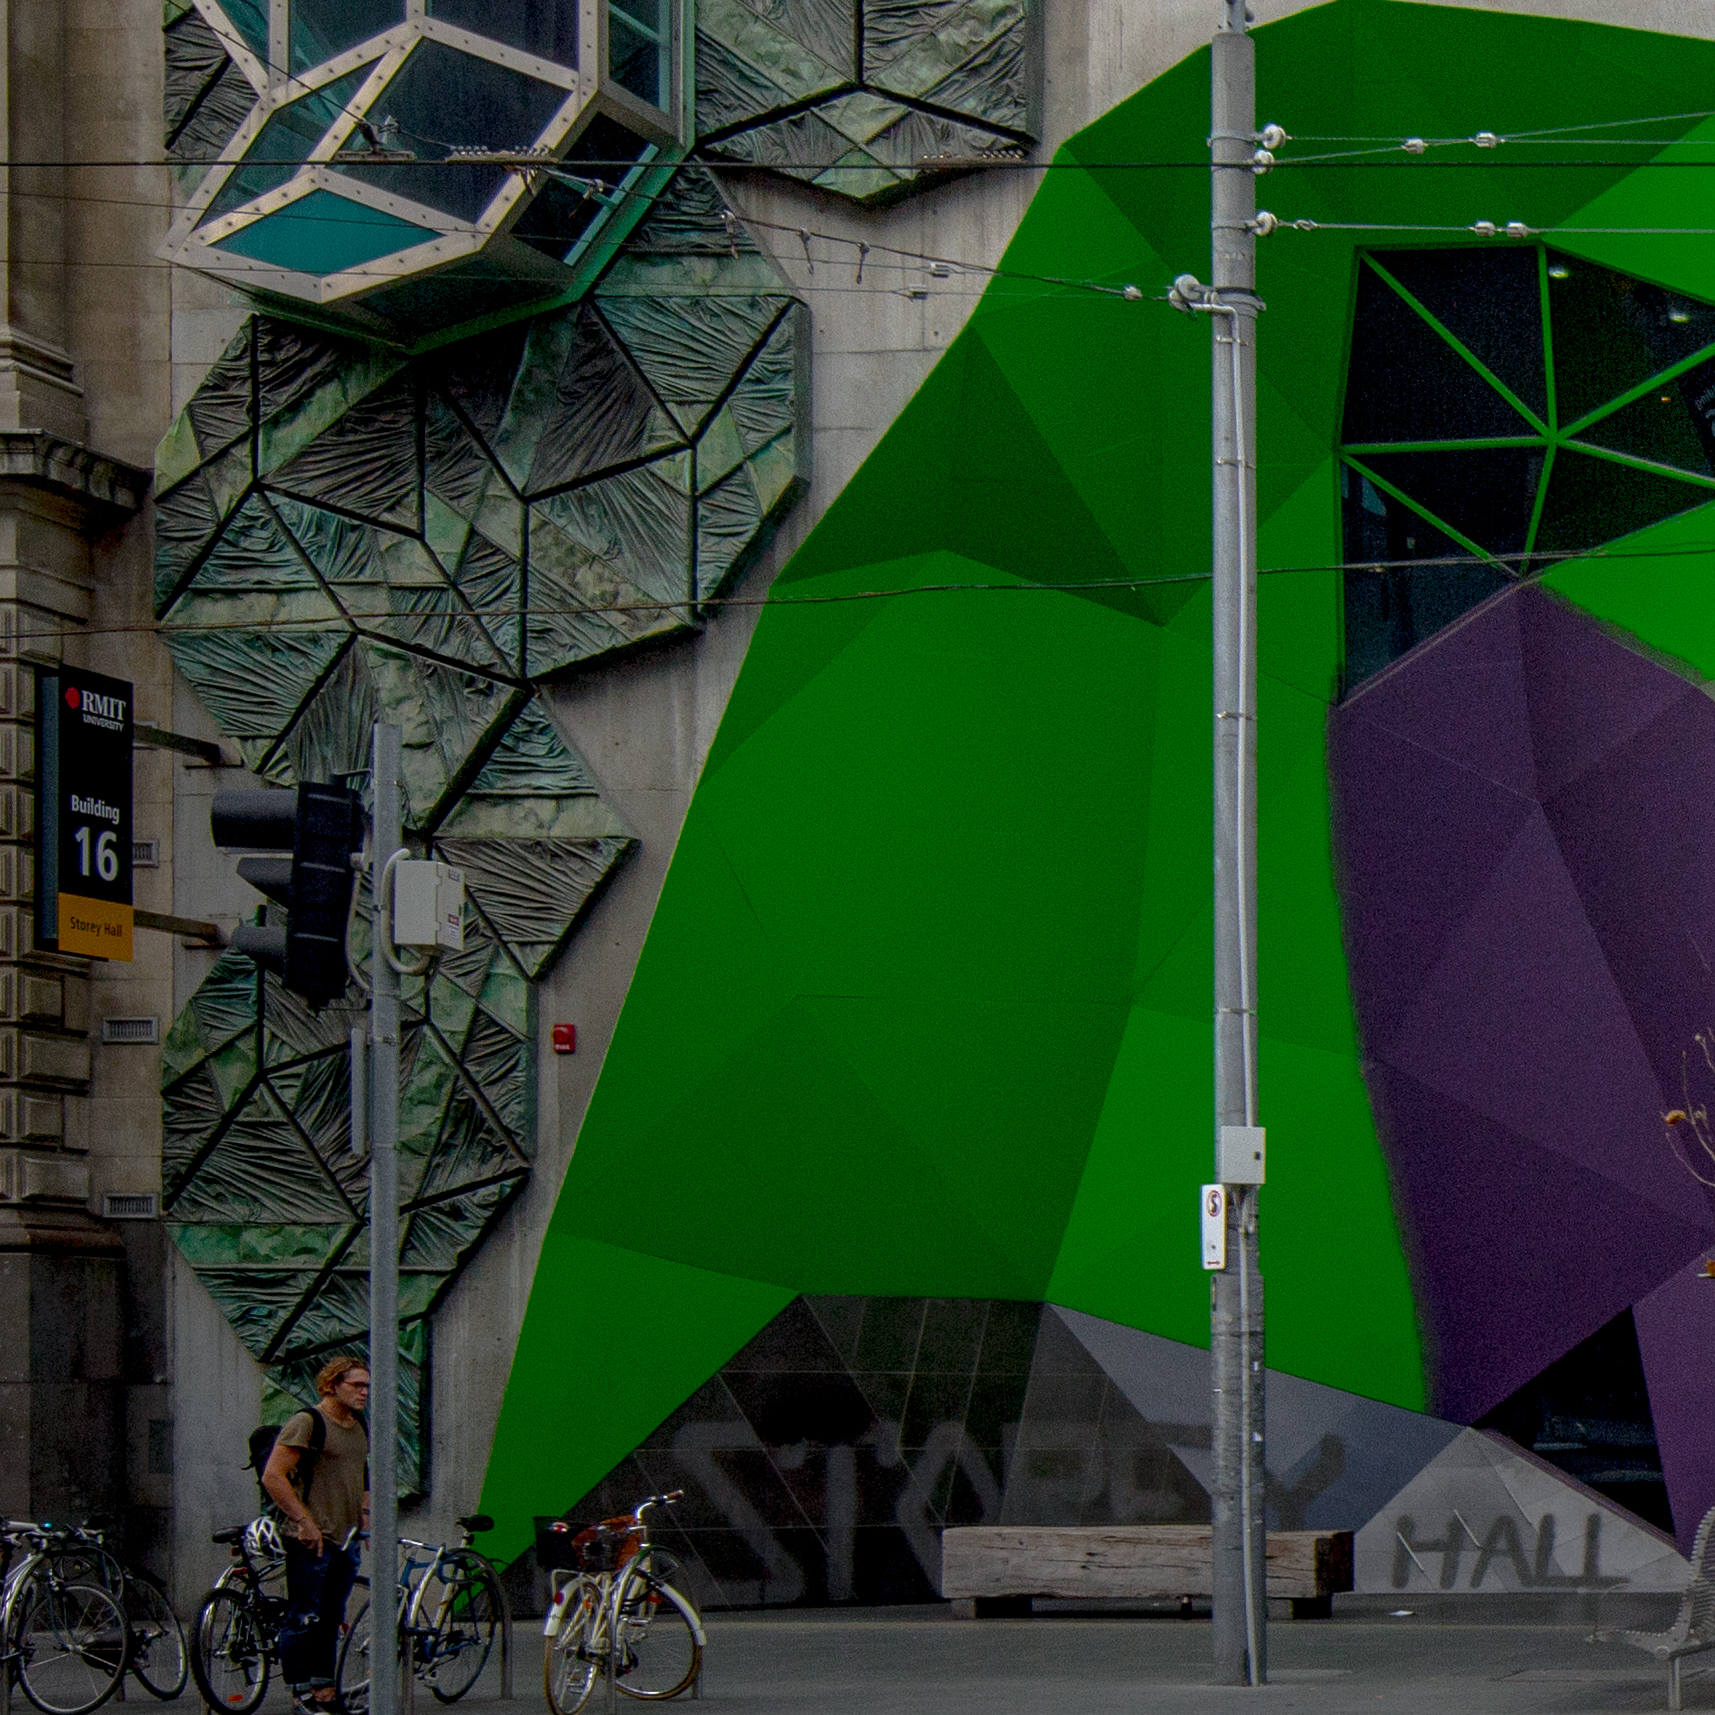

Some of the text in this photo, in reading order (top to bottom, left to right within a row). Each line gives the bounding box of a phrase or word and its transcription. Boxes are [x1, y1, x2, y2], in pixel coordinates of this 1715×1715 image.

[80, 689, 127, 722] RMIT
[82, 713, 125, 733] UNIVERSITY
[70, 793, 121, 826] Building
[73, 825, 120, 882] 16
[70, 915, 123, 939] Storey Hall
[1391, 1513, 1631, 1590] HALL
